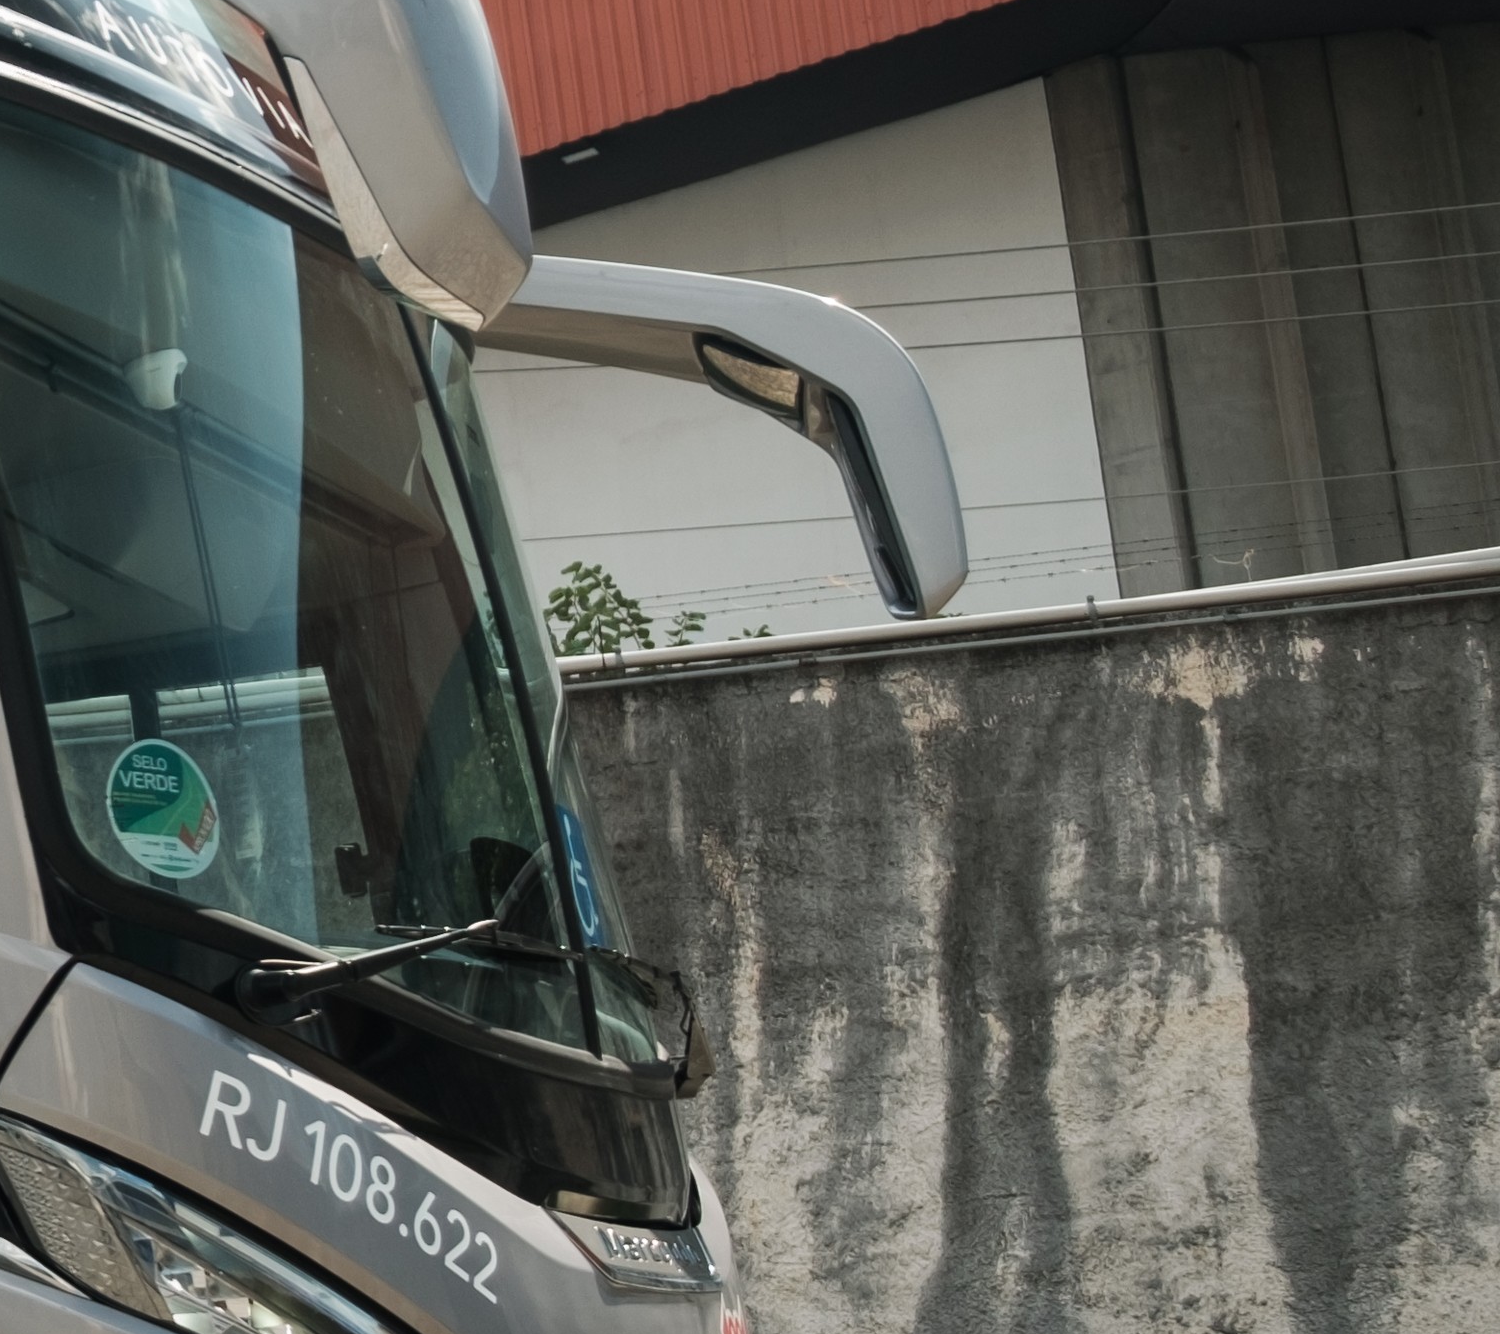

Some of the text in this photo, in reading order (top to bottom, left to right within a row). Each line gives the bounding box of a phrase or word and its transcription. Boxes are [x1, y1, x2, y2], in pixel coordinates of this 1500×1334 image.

[131, 753, 167, 772] SELO
[118, 769, 180, 794] VERDE
[199, 1069, 500, 1305] RJ 108.622
